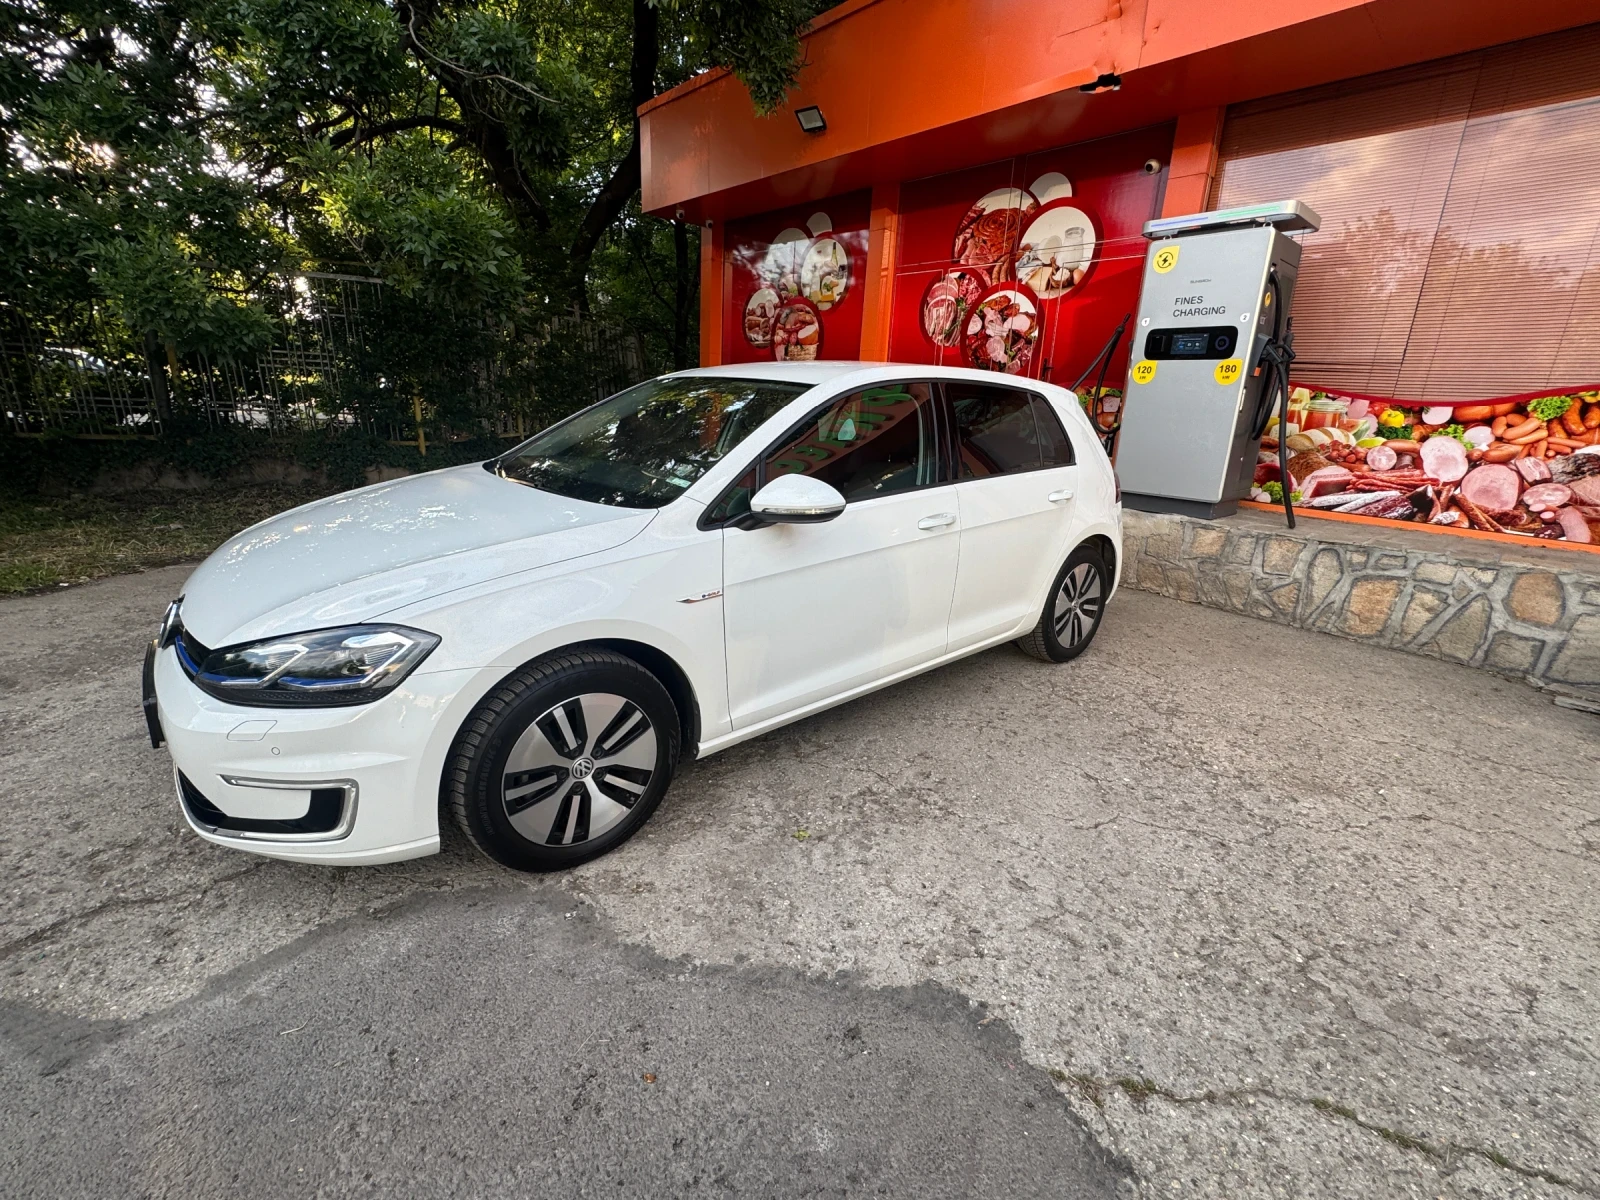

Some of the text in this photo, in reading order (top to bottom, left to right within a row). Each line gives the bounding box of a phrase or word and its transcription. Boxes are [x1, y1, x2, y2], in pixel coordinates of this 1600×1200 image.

[1174, 295, 1204, 305] FINES
[1172, 306, 1226, 317] CHARGING
[1137, 365, 1152, 375] 120
[1219, 364, 1237, 374] 180
